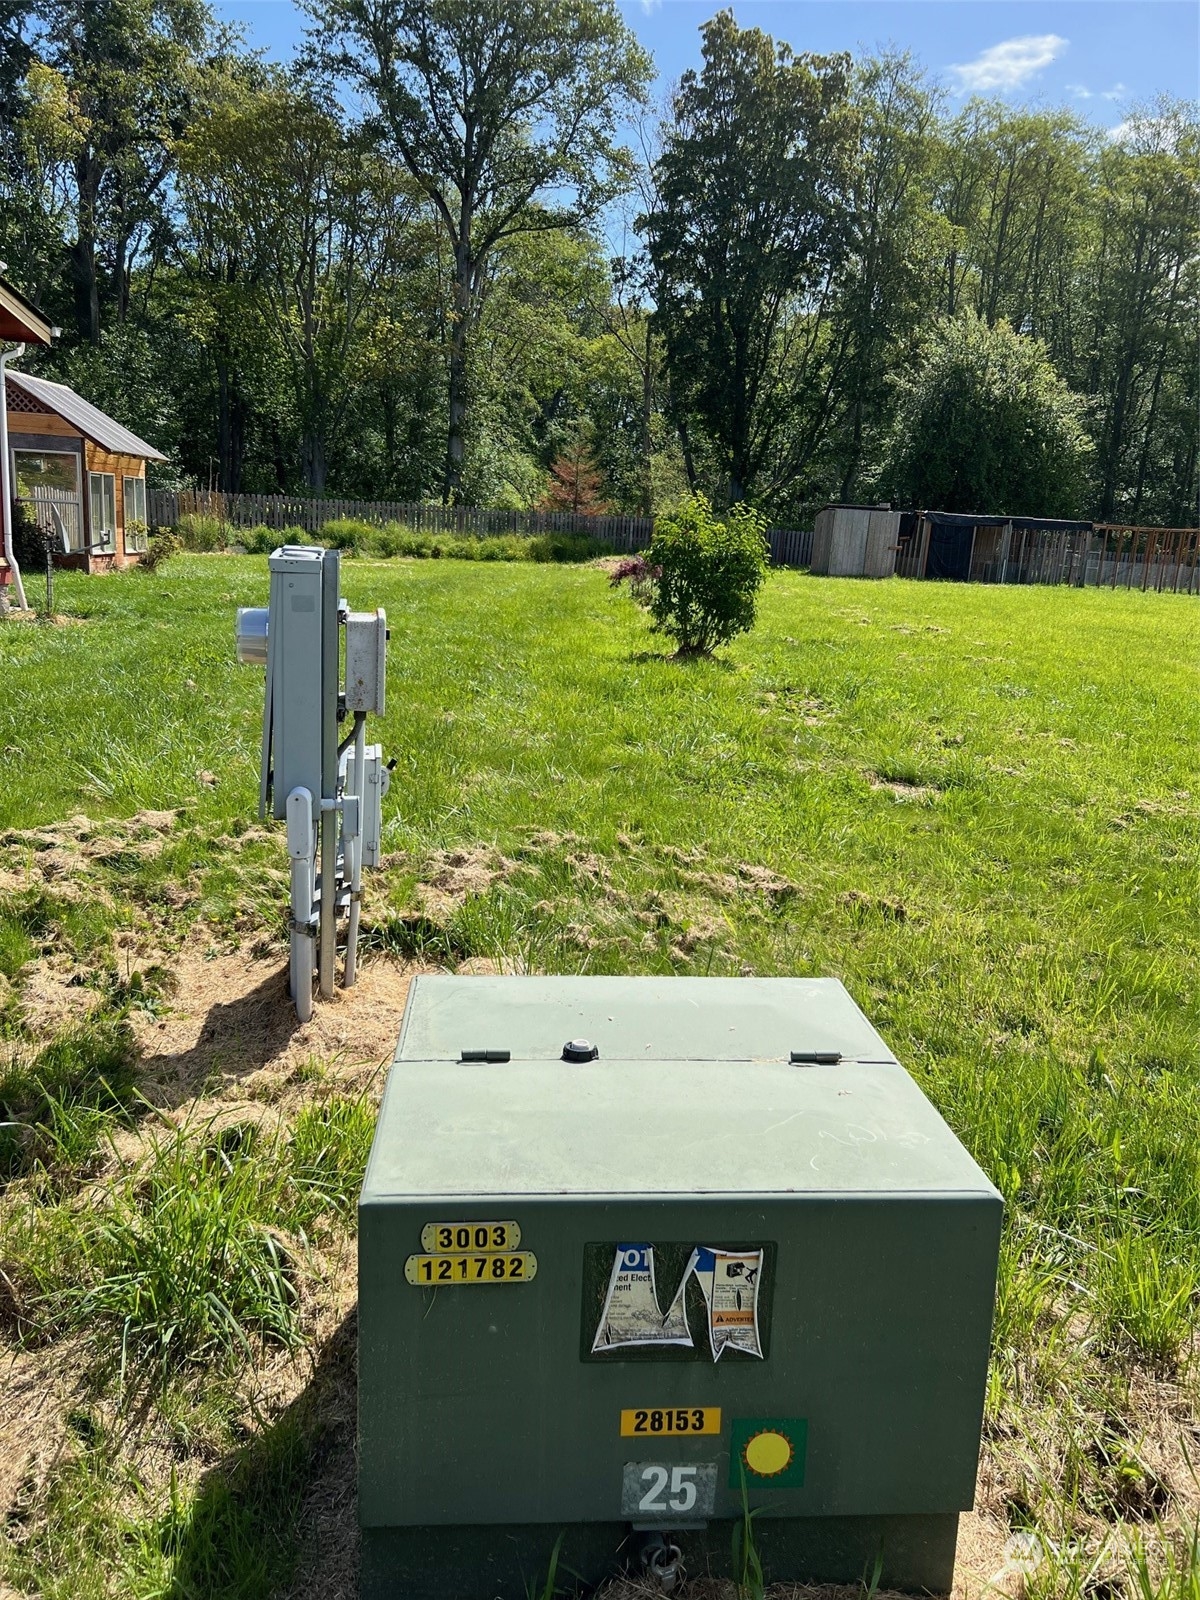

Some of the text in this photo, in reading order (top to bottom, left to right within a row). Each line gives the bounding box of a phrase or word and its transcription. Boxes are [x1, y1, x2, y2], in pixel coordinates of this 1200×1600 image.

[439, 1226, 506, 1248] 3003
[422, 1258, 523, 1280] 121782
[631, 1274, 652, 1282] Elect
[634, 1410, 705, 1432] 28153
[639, 1466, 697, 1511] 25
